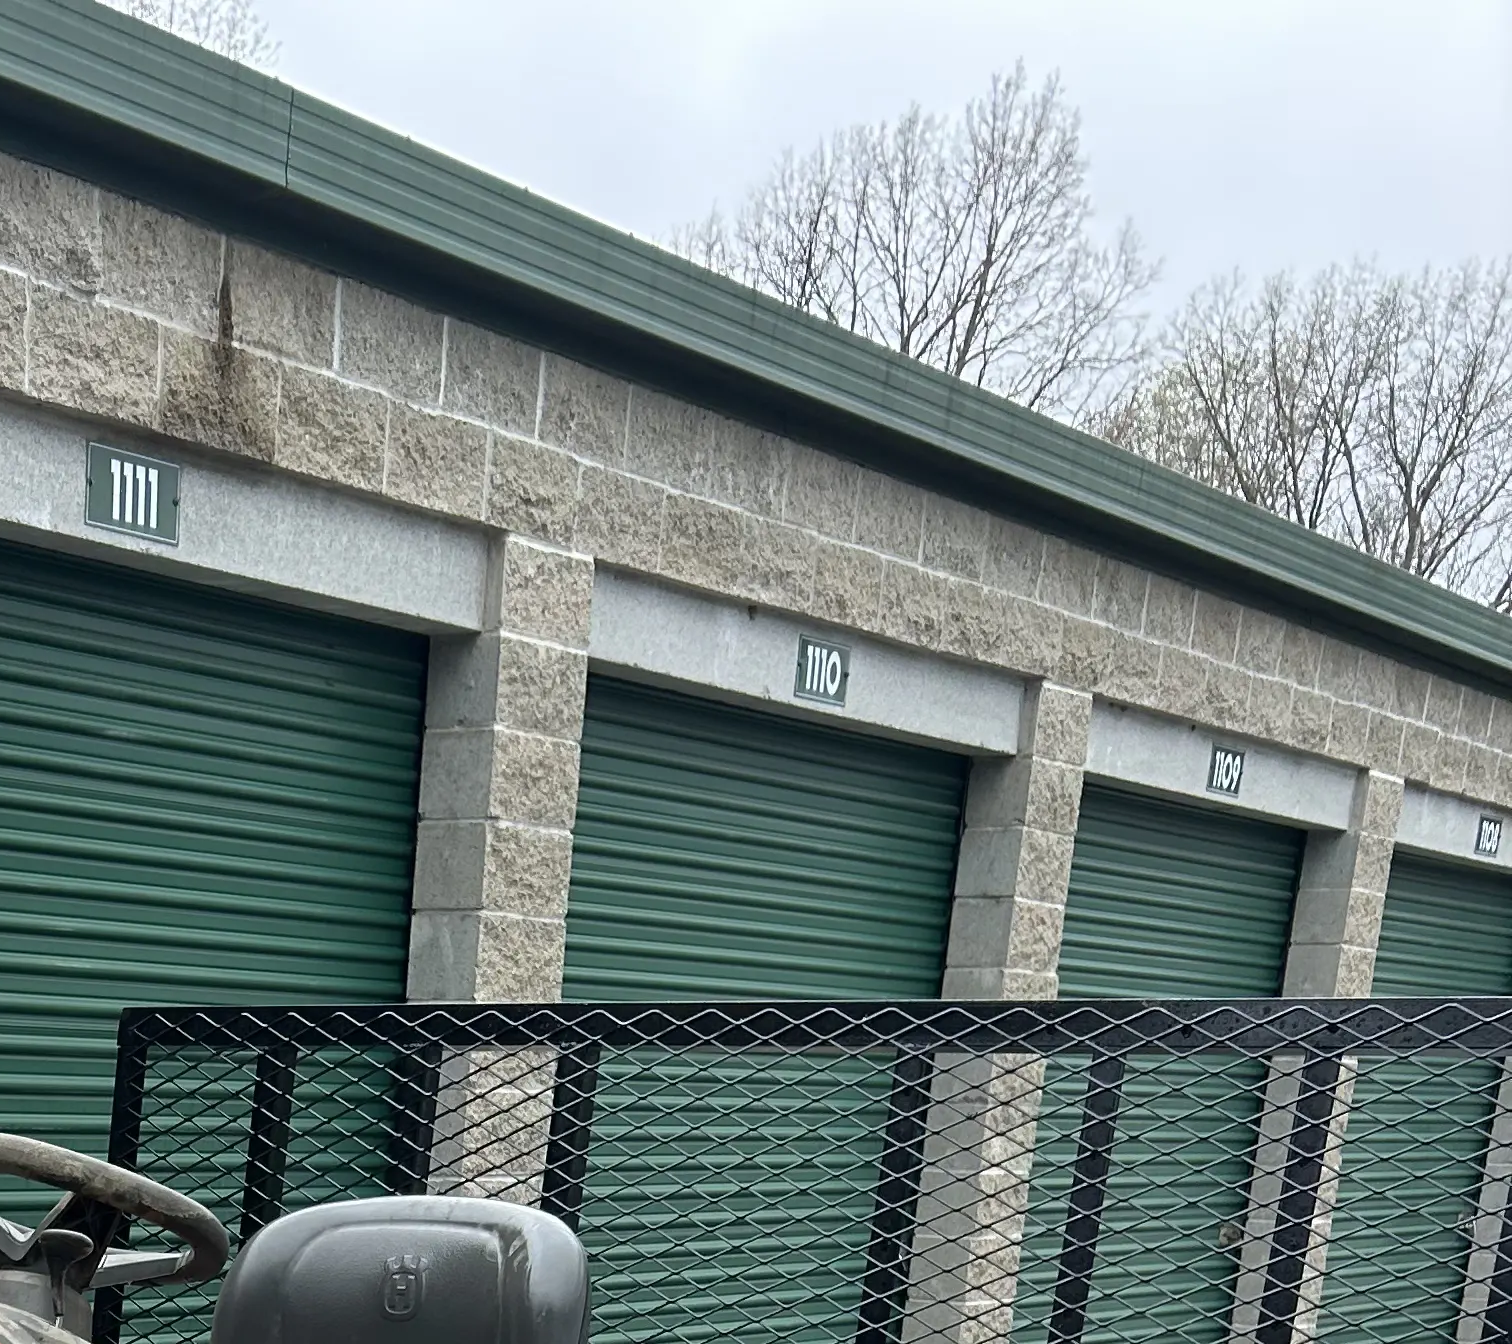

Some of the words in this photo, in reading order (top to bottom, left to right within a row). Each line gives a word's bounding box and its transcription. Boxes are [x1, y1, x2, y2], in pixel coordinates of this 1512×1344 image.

[110, 458, 159, 529] 1111
[805, 645, 842, 696] 1110
[1212, 751, 1241, 791] 1109
